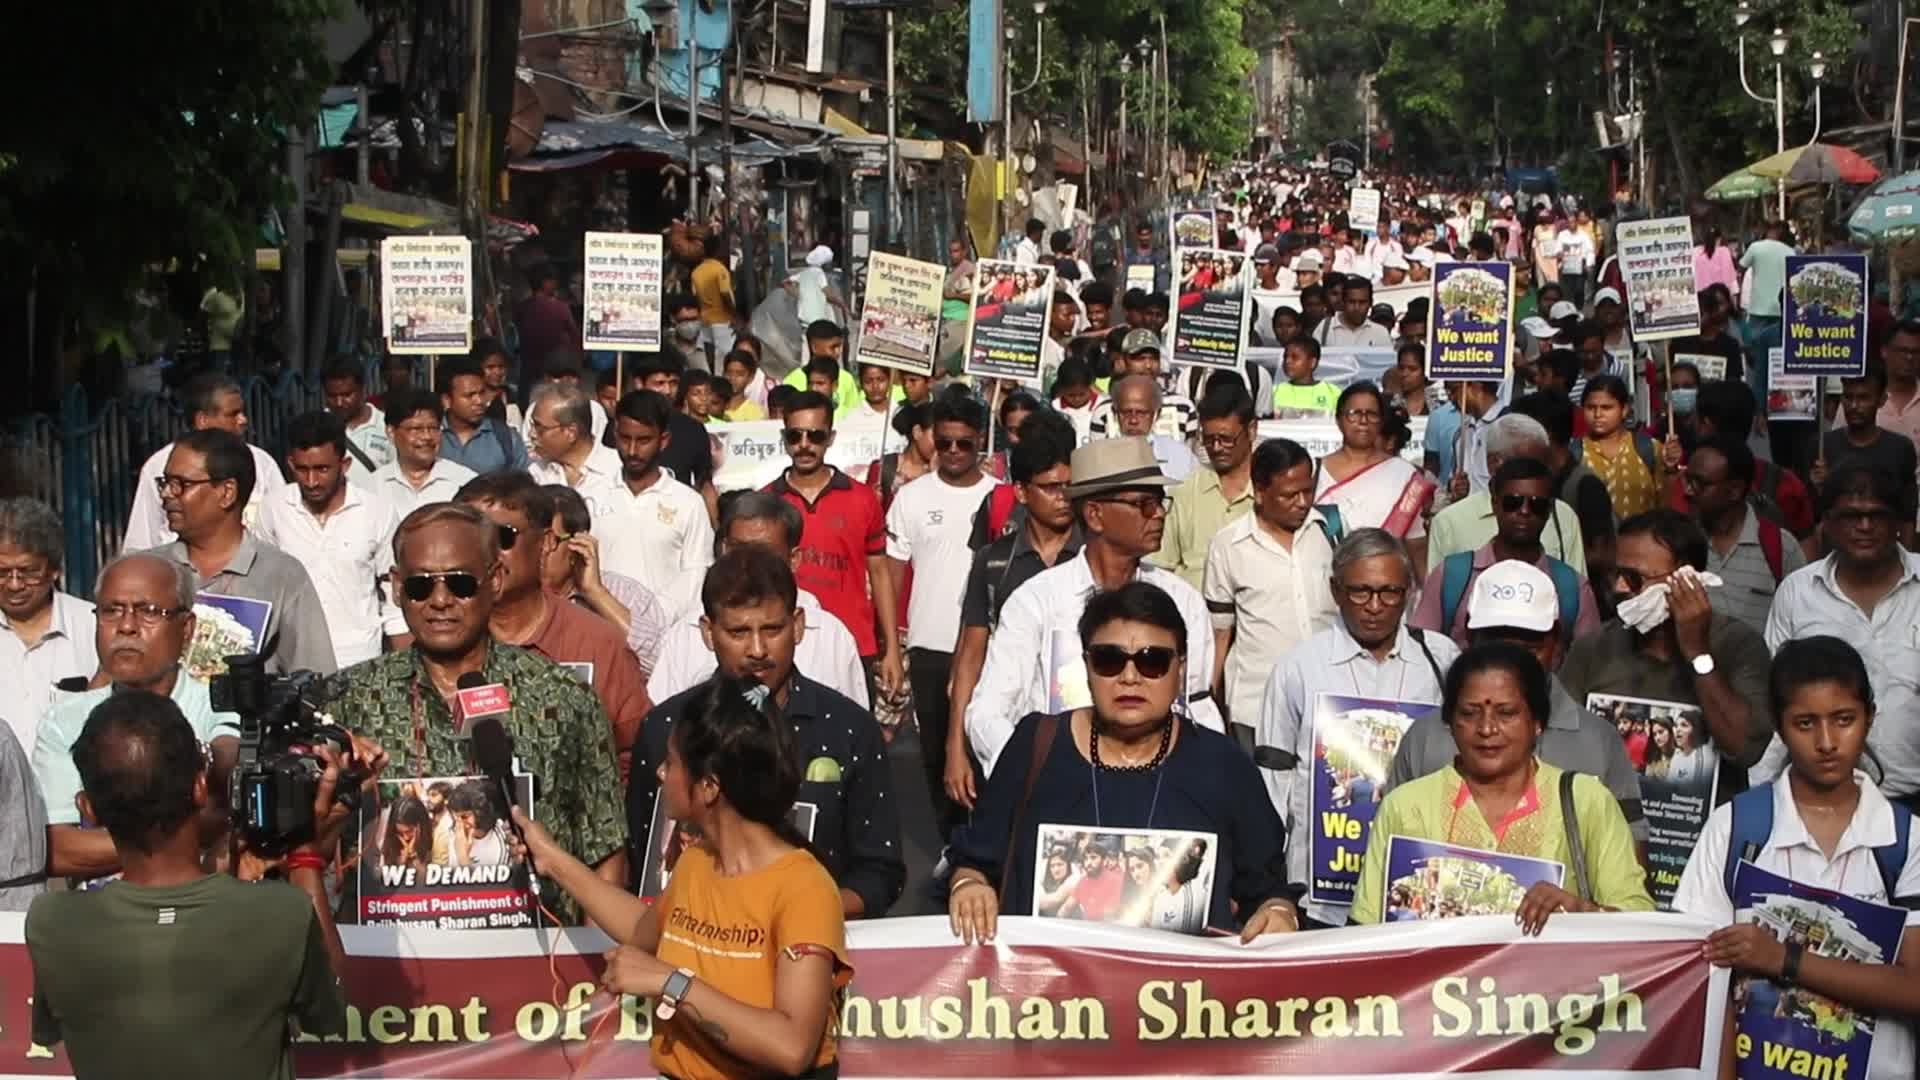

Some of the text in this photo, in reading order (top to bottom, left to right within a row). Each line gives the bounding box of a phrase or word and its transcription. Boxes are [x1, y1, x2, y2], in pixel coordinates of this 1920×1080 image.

[1437, 328, 1500, 344] We want
[1791, 323, 1856, 339] We want
[1440, 346, 1494, 362] Justice
[1794, 342, 1851, 358] Justice
[1322, 811, 1361, 840] We
[382, 864, 511, 886] WE DEMAND
[367, 894, 528, 916] Stringent Punishment of
[439, 916, 488, 930] Sharan
[490, 911, 532, 928] Singh,
[515, 982, 603, 1042] of
[1137, 977, 1403, 1041] Sharan
[1432, 973, 1646, 1057] Singh
[1762, 1041, 1849, 1080] want
